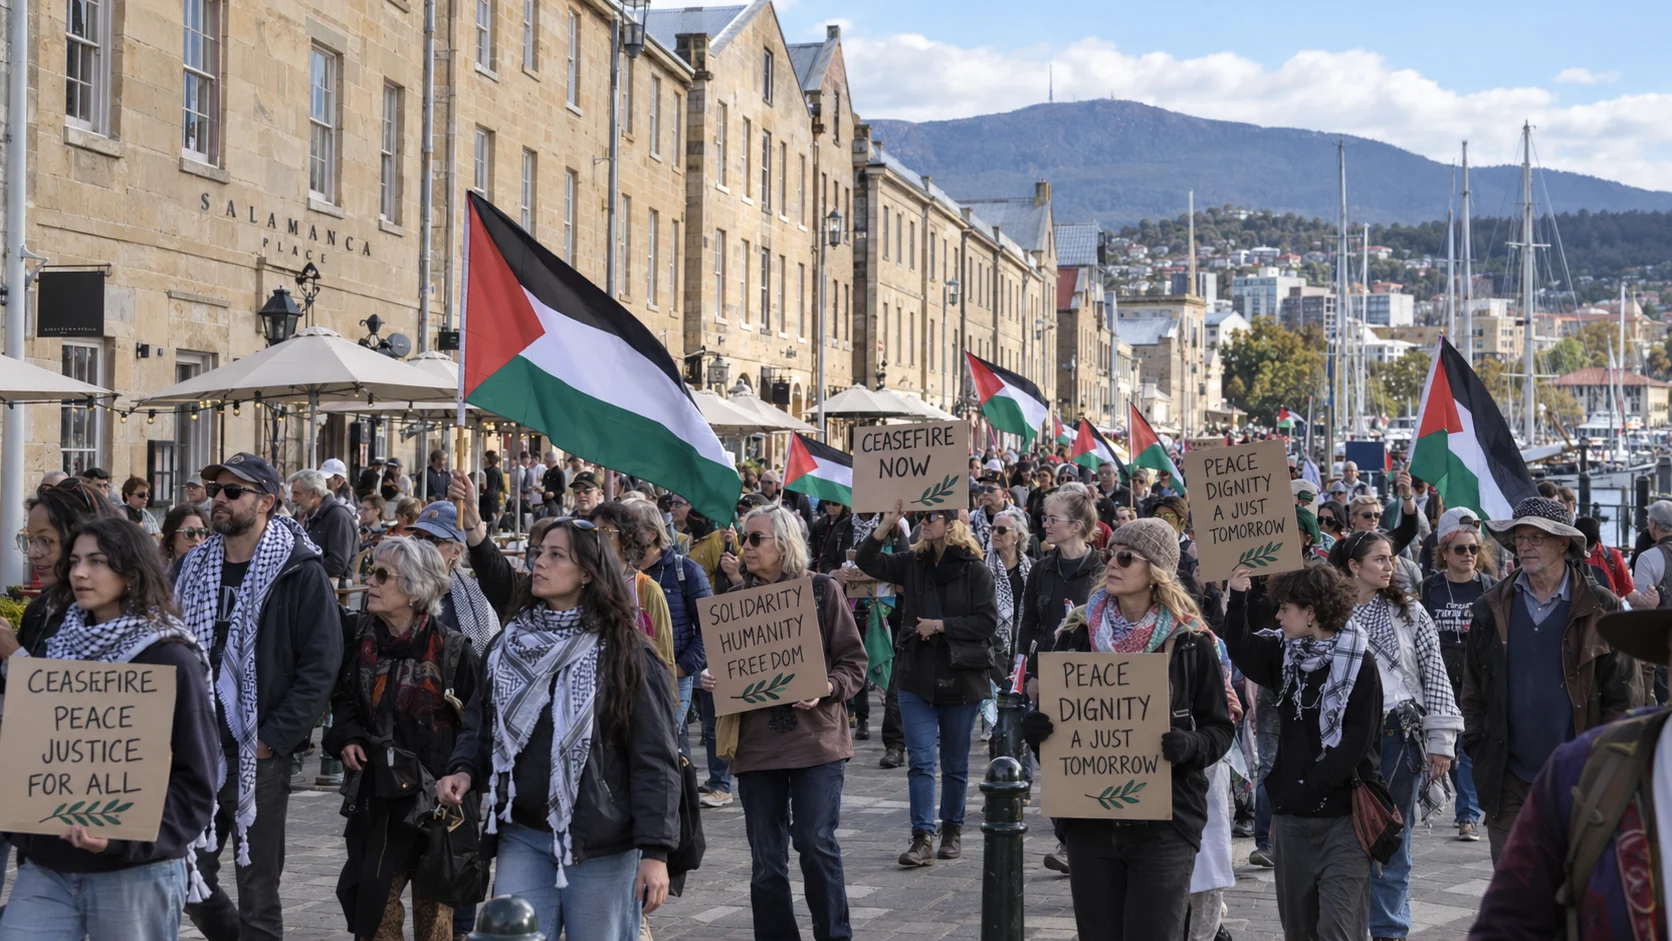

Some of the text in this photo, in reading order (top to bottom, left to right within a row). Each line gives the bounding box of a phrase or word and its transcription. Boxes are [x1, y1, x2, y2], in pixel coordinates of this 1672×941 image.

[200, 193, 371, 256] SALAMANCA
[263, 237, 326, 264] PLACE
[862, 426, 955, 453] CEASEFIRE
[879, 455, 931, 479] NOW
[1204, 452, 1258, 478] PEACE
[1205, 473, 1271, 500] DIGNITY
[1213, 498, 1268, 521] A JUST
[1209, 517, 1285, 544] TOMORROW
[709, 585, 802, 626] SOLIDARITY
[719, 614, 803, 654] HUMANITY
[727, 645, 804, 680] FREEDOM
[1062, 662, 1130, 688] PEACE
[28, 669, 157, 693] CEASEFIRE
[55, 705, 135, 731] PEACE
[1059, 694, 1151, 722] DIGNITY
[42, 738, 143, 764] JUSTICE
[1070, 729, 1134, 749] A JUST
[1059, 754, 1159, 776] TOMORROW
[28, 772, 142, 797] FOR ALL
